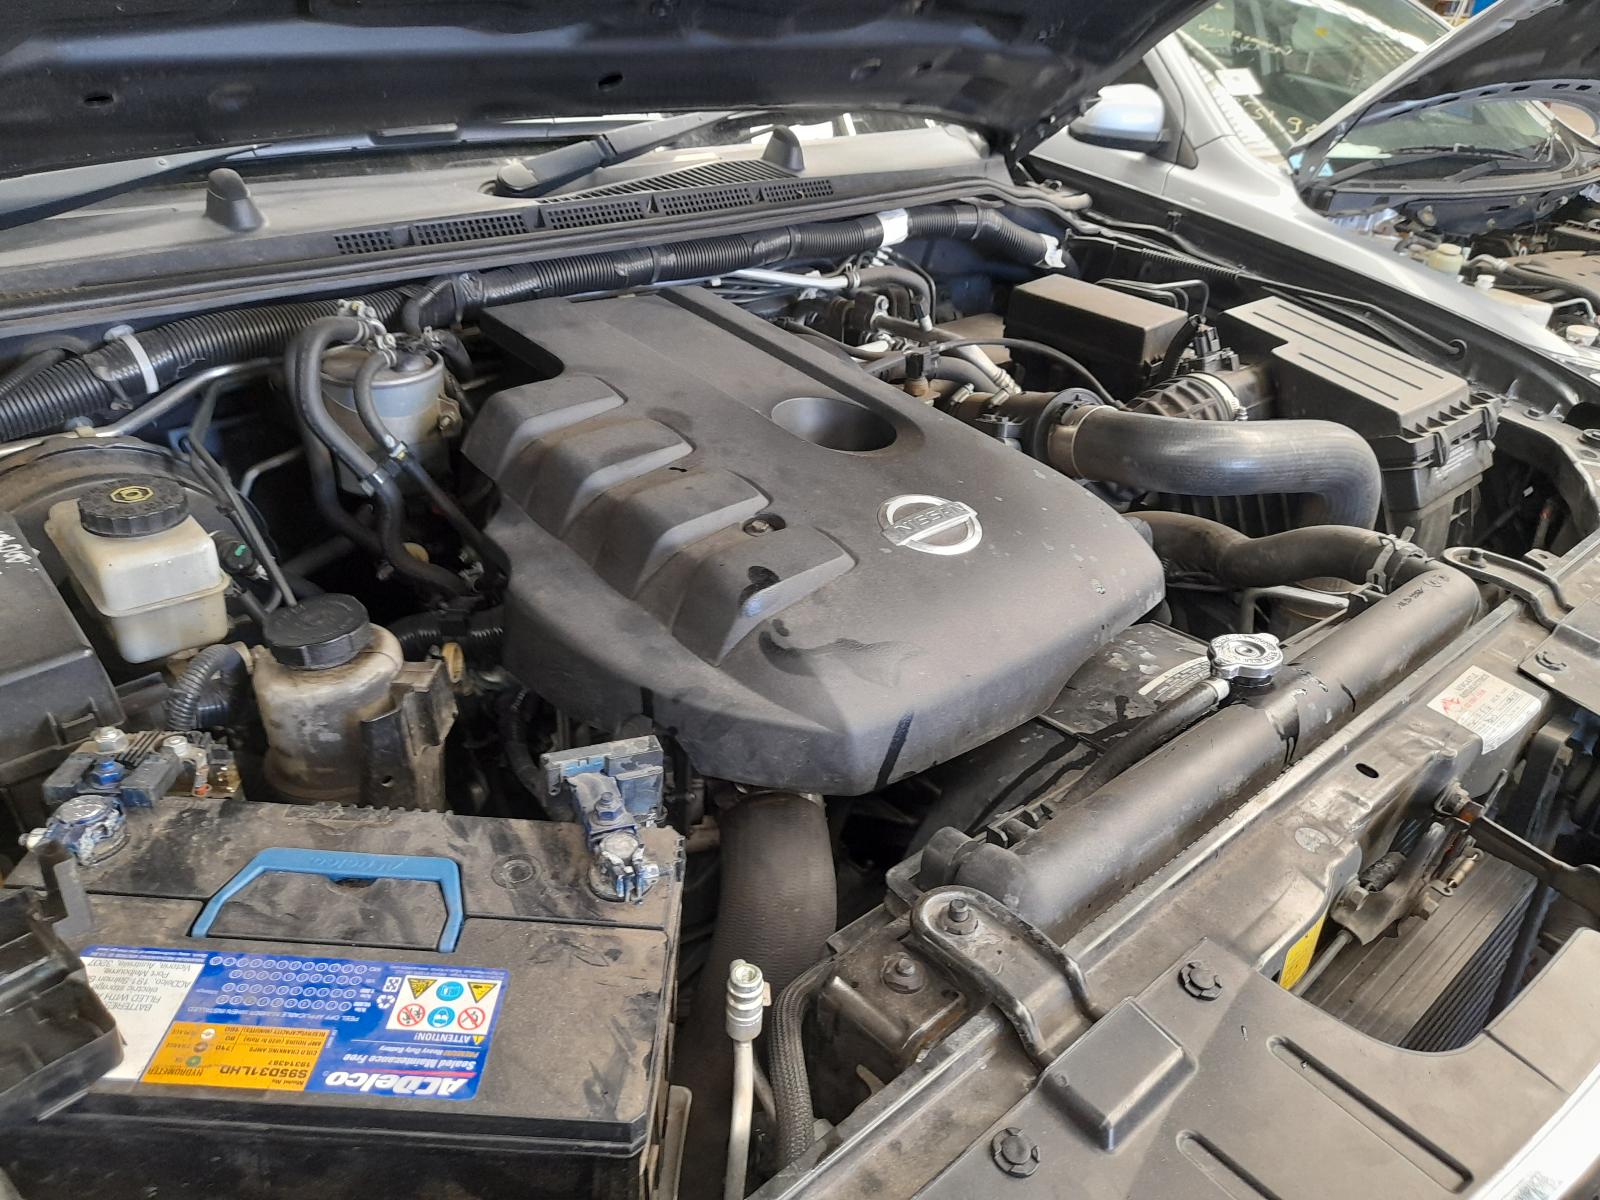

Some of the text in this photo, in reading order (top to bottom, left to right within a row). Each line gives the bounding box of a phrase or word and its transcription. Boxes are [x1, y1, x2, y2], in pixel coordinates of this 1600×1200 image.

[892, 503, 966, 532] NISSAN
[150, 970, 169, 978] Port
[104, 992, 129, 1002] WITH
[130, 994, 162, 1003] FILLED
[413, 1032, 471, 1044] ATTENTION!
[406, 1046, 421, 1054] Duty
[422, 1047, 444, 1056] Heavy
[342, 1053, 476, 1070] Sealed Maintenance Free
[220, 1066, 308, 1079] S95D31LHD
[325, 1071, 468, 1096] ACDelco
